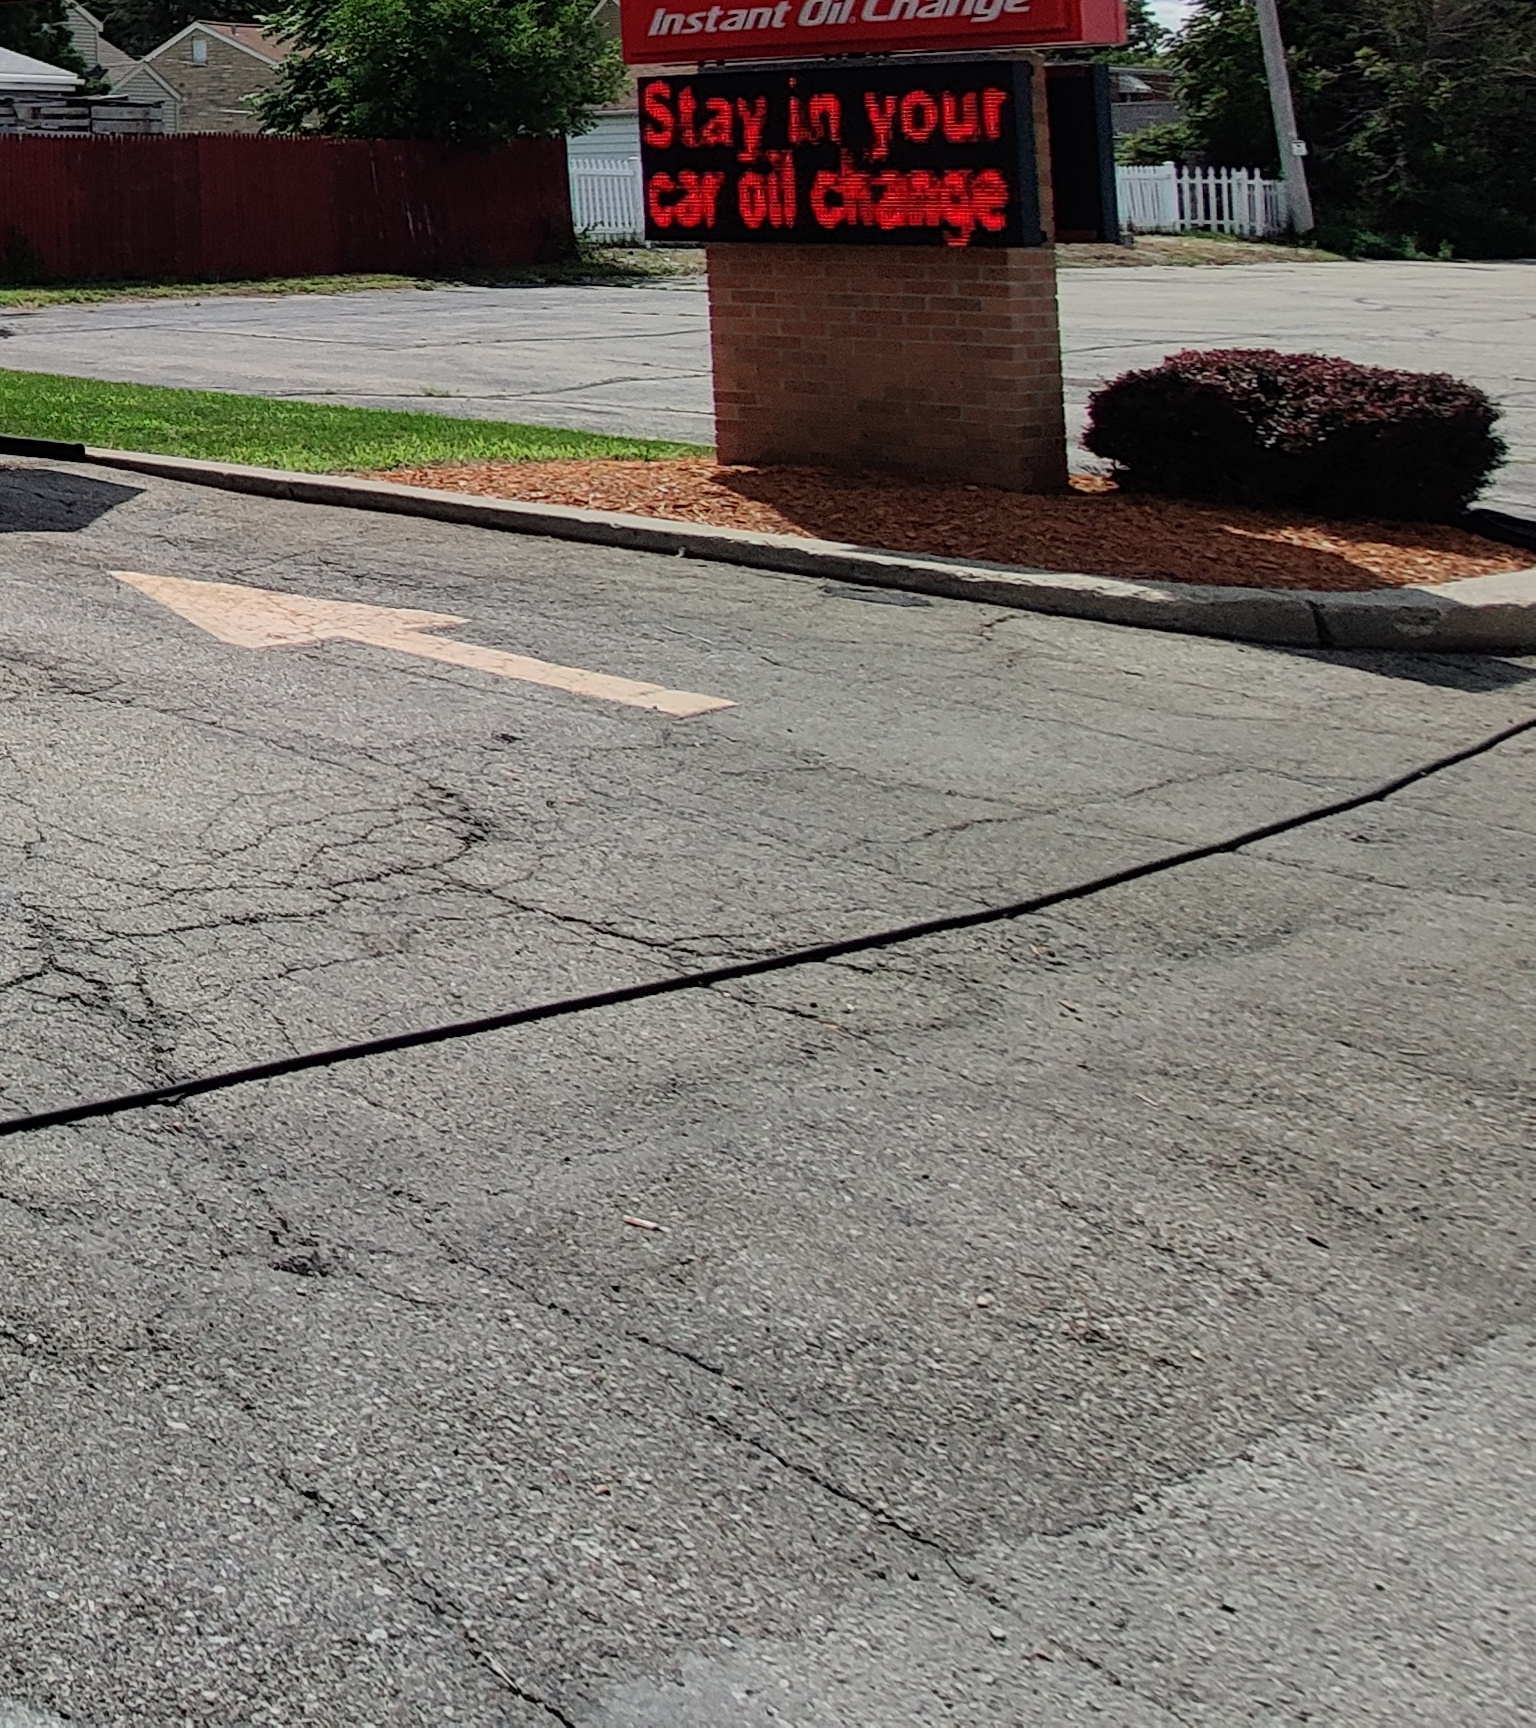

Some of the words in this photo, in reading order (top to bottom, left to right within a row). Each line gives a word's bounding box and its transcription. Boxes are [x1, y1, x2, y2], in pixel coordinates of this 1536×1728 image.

[647, 0, 792, 37] Instant
[643, 79, 767, 163] Stay
[787, 75, 842, 145] in
[864, 87, 1009, 162] your
[648, 168, 725, 230] car
[737, 148, 798, 230] oil
[809, 148, 1010, 248] change
